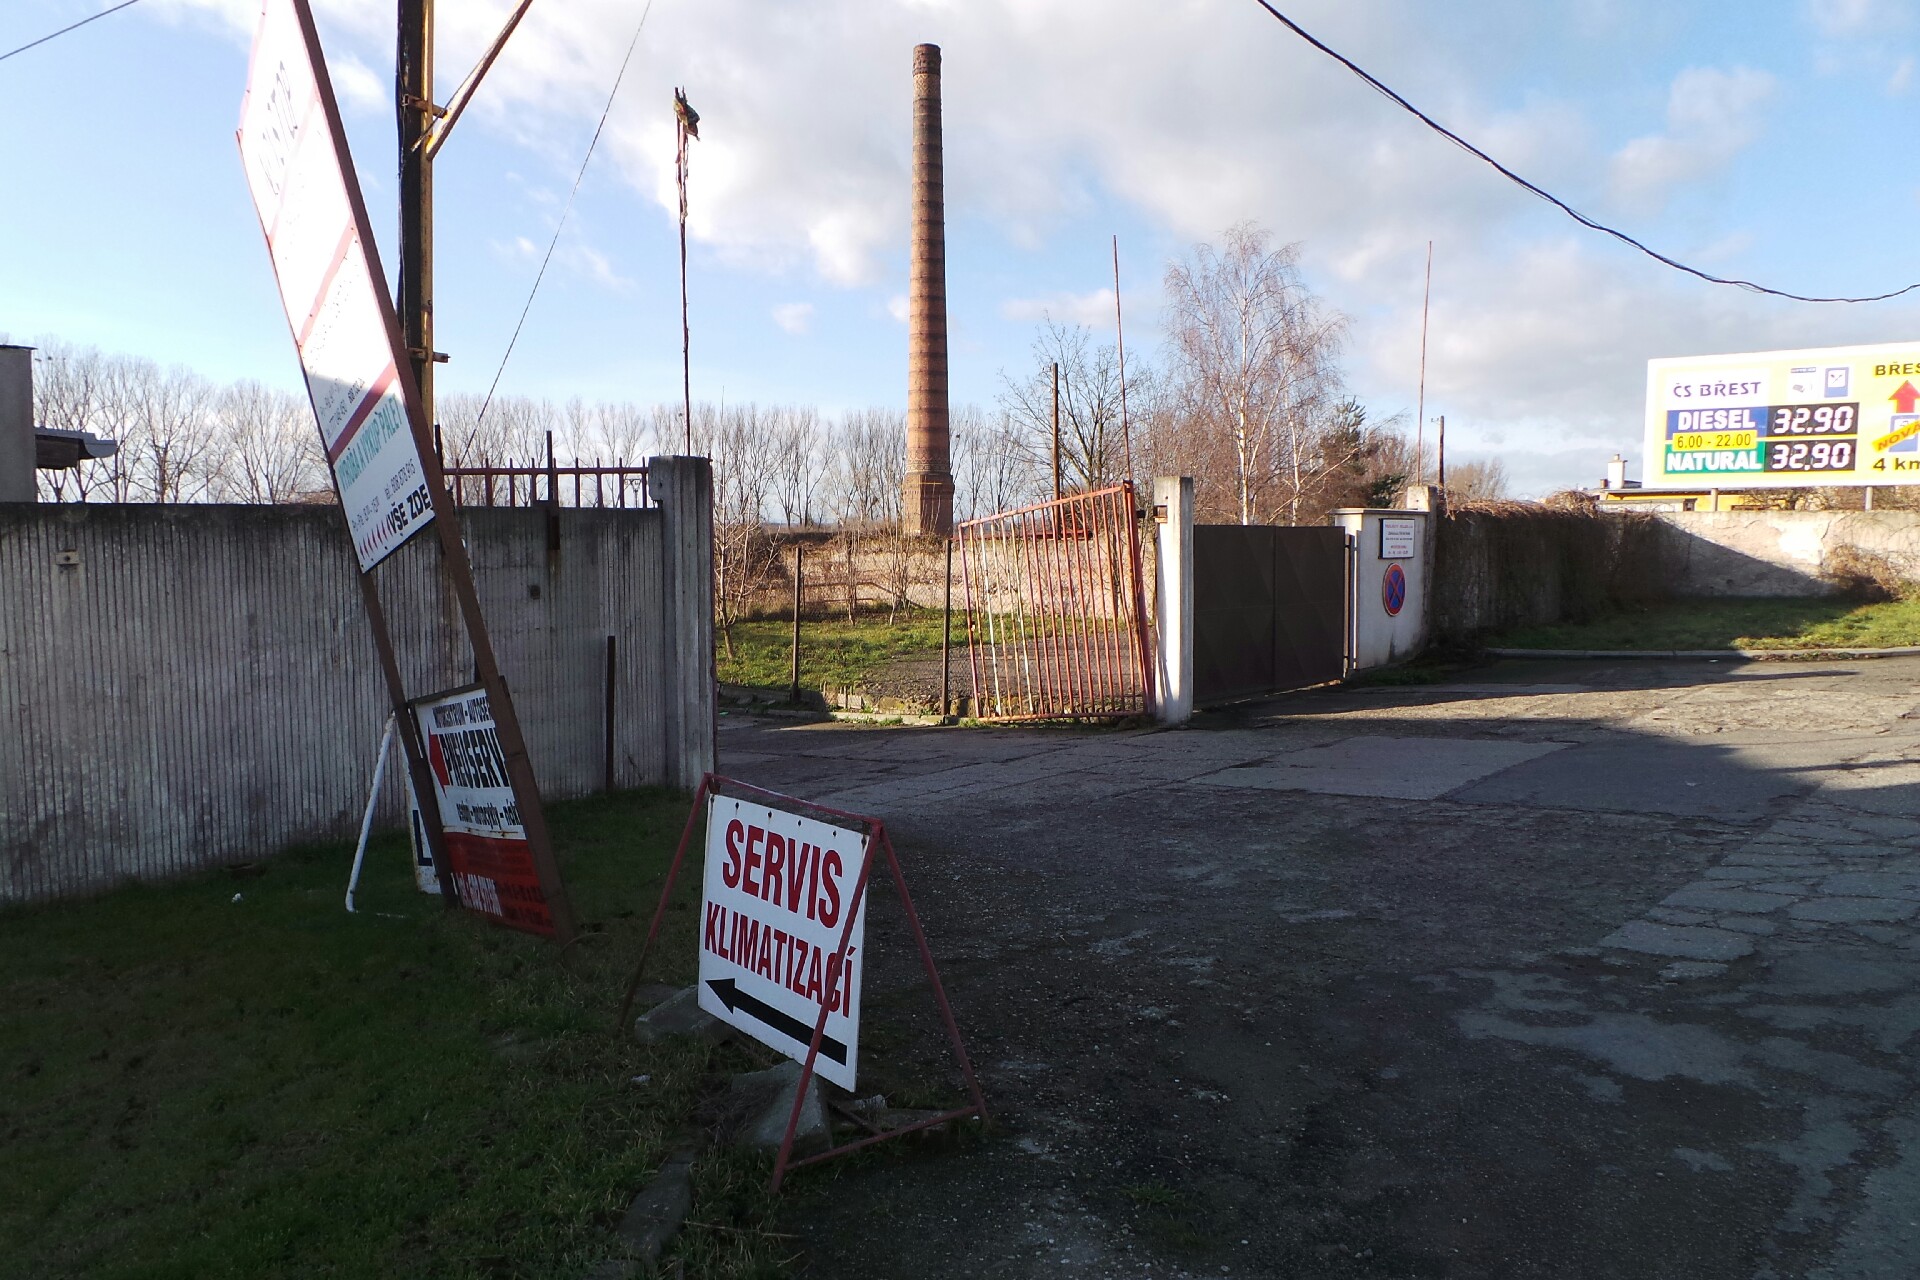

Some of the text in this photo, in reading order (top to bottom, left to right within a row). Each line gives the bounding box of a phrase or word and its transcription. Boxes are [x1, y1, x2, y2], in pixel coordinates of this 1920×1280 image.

[1673, 380, 1761, 398] ČS BŘEST
[1678, 409, 1756, 431] DIESEL
[1677, 435, 1703, 448] 6.00
[1716, 433, 1751, 447] 22.00
[1666, 450, 1763, 472] NATURAL
[1873, 457, 1886, 471] 4
[388, 502, 408, 534] VŠE
[406, 483, 430, 521] ZDE
[722, 818, 843, 929] SERVIS
[704, 900, 857, 1019] KLIMATIZACÍ
